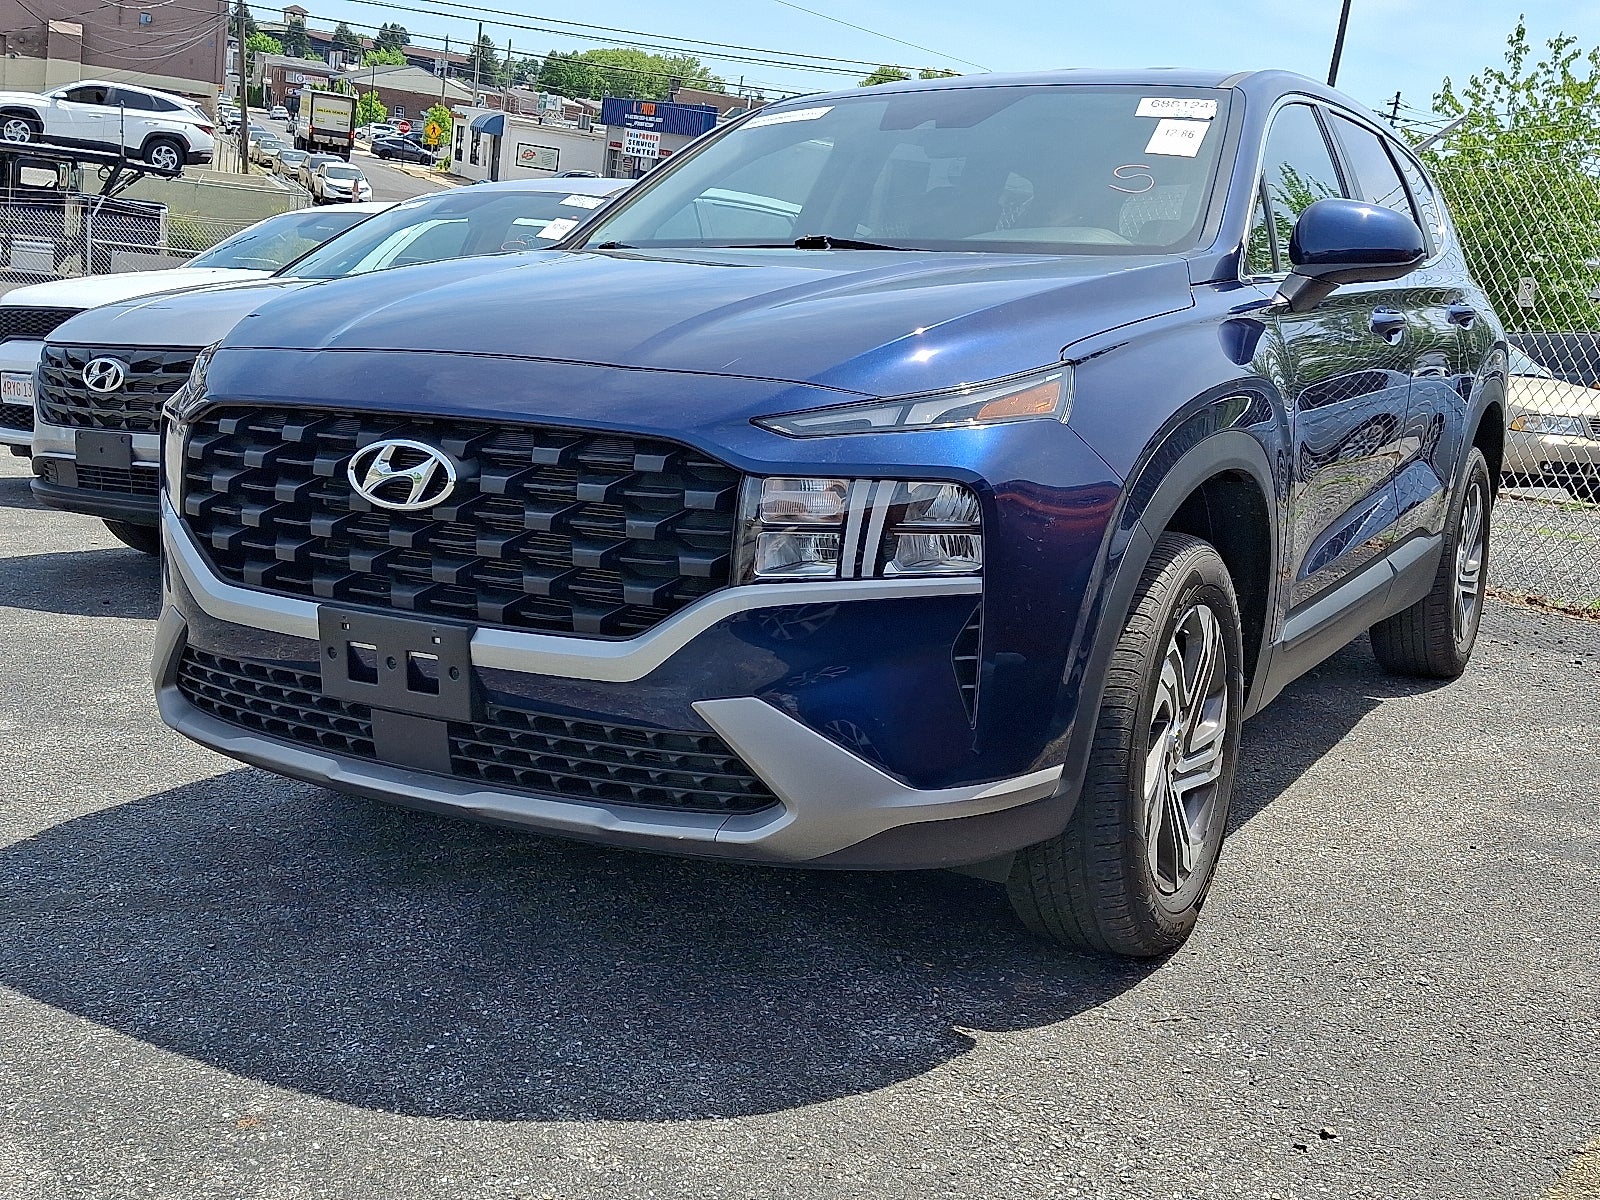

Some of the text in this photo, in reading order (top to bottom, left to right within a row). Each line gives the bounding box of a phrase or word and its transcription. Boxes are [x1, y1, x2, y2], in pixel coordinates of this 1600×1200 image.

[627, 138, 655, 149] SERVICE
[625, 146, 656, 156] CENTER
[1108, 164, 1156, 194] S
